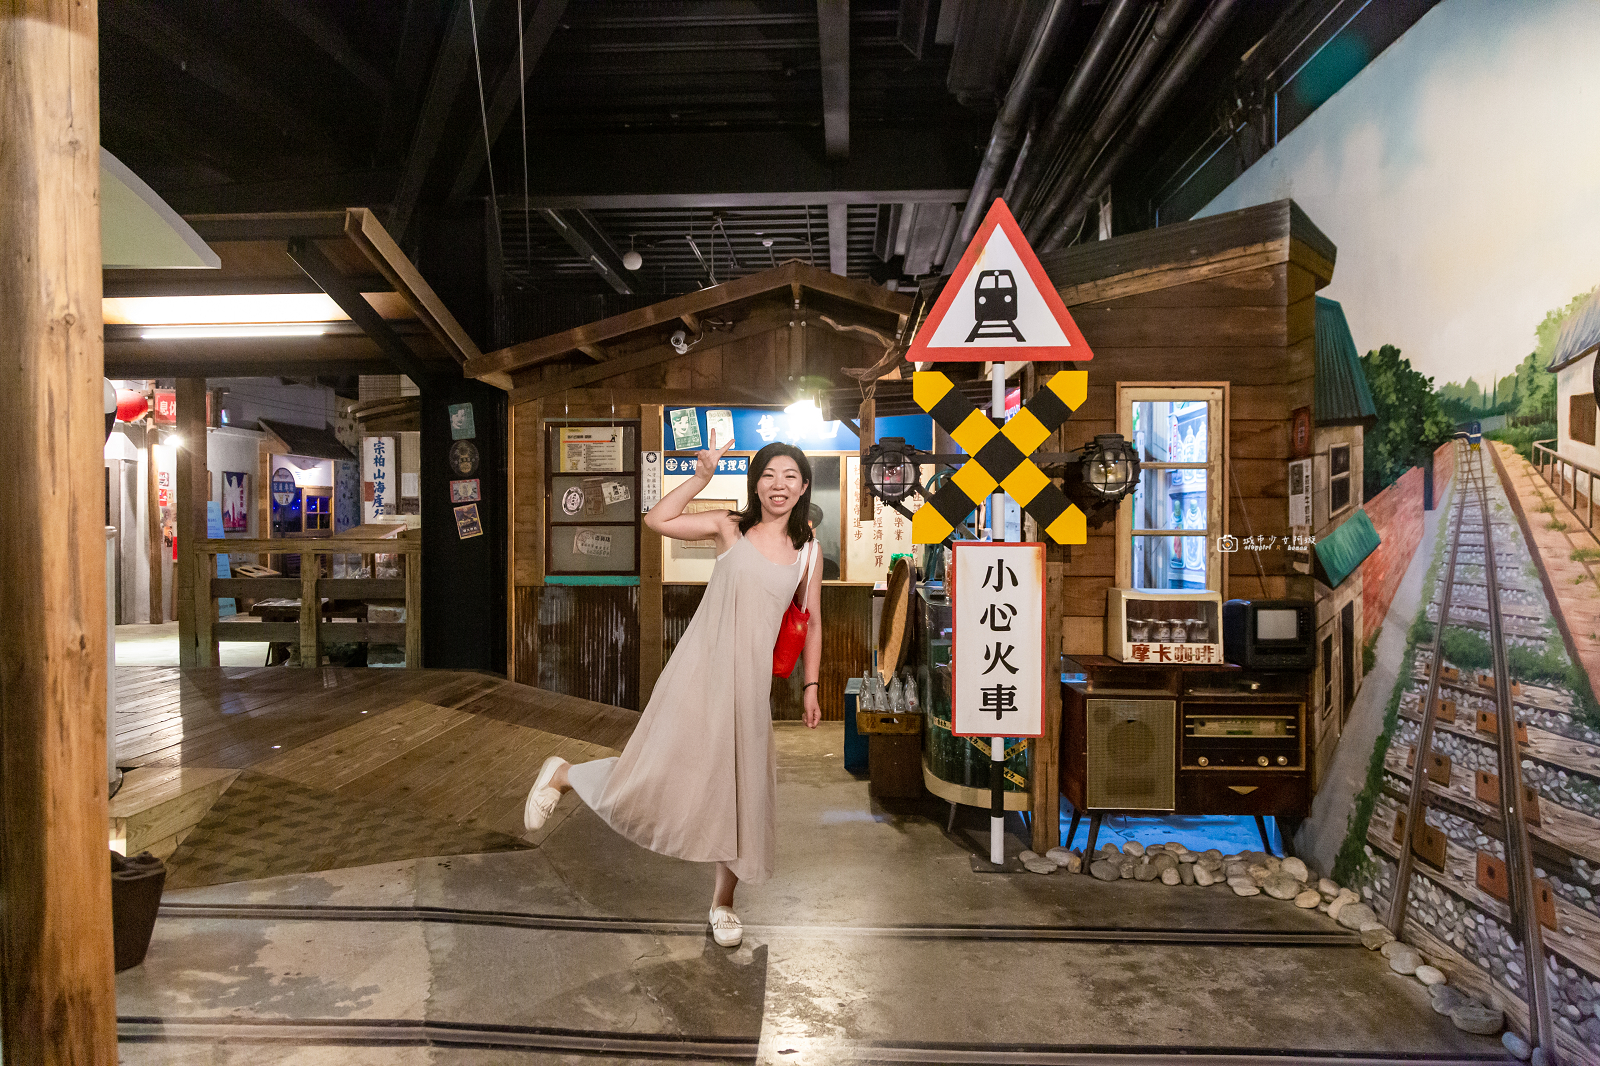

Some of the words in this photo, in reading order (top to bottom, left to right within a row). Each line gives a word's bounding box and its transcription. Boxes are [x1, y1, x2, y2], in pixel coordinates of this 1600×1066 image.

[680, 459, 747, 472] 台灣管理局
[979, 558, 1020, 721] 小心火車
[1131, 643, 1215, 663] 摩卡咖啡
